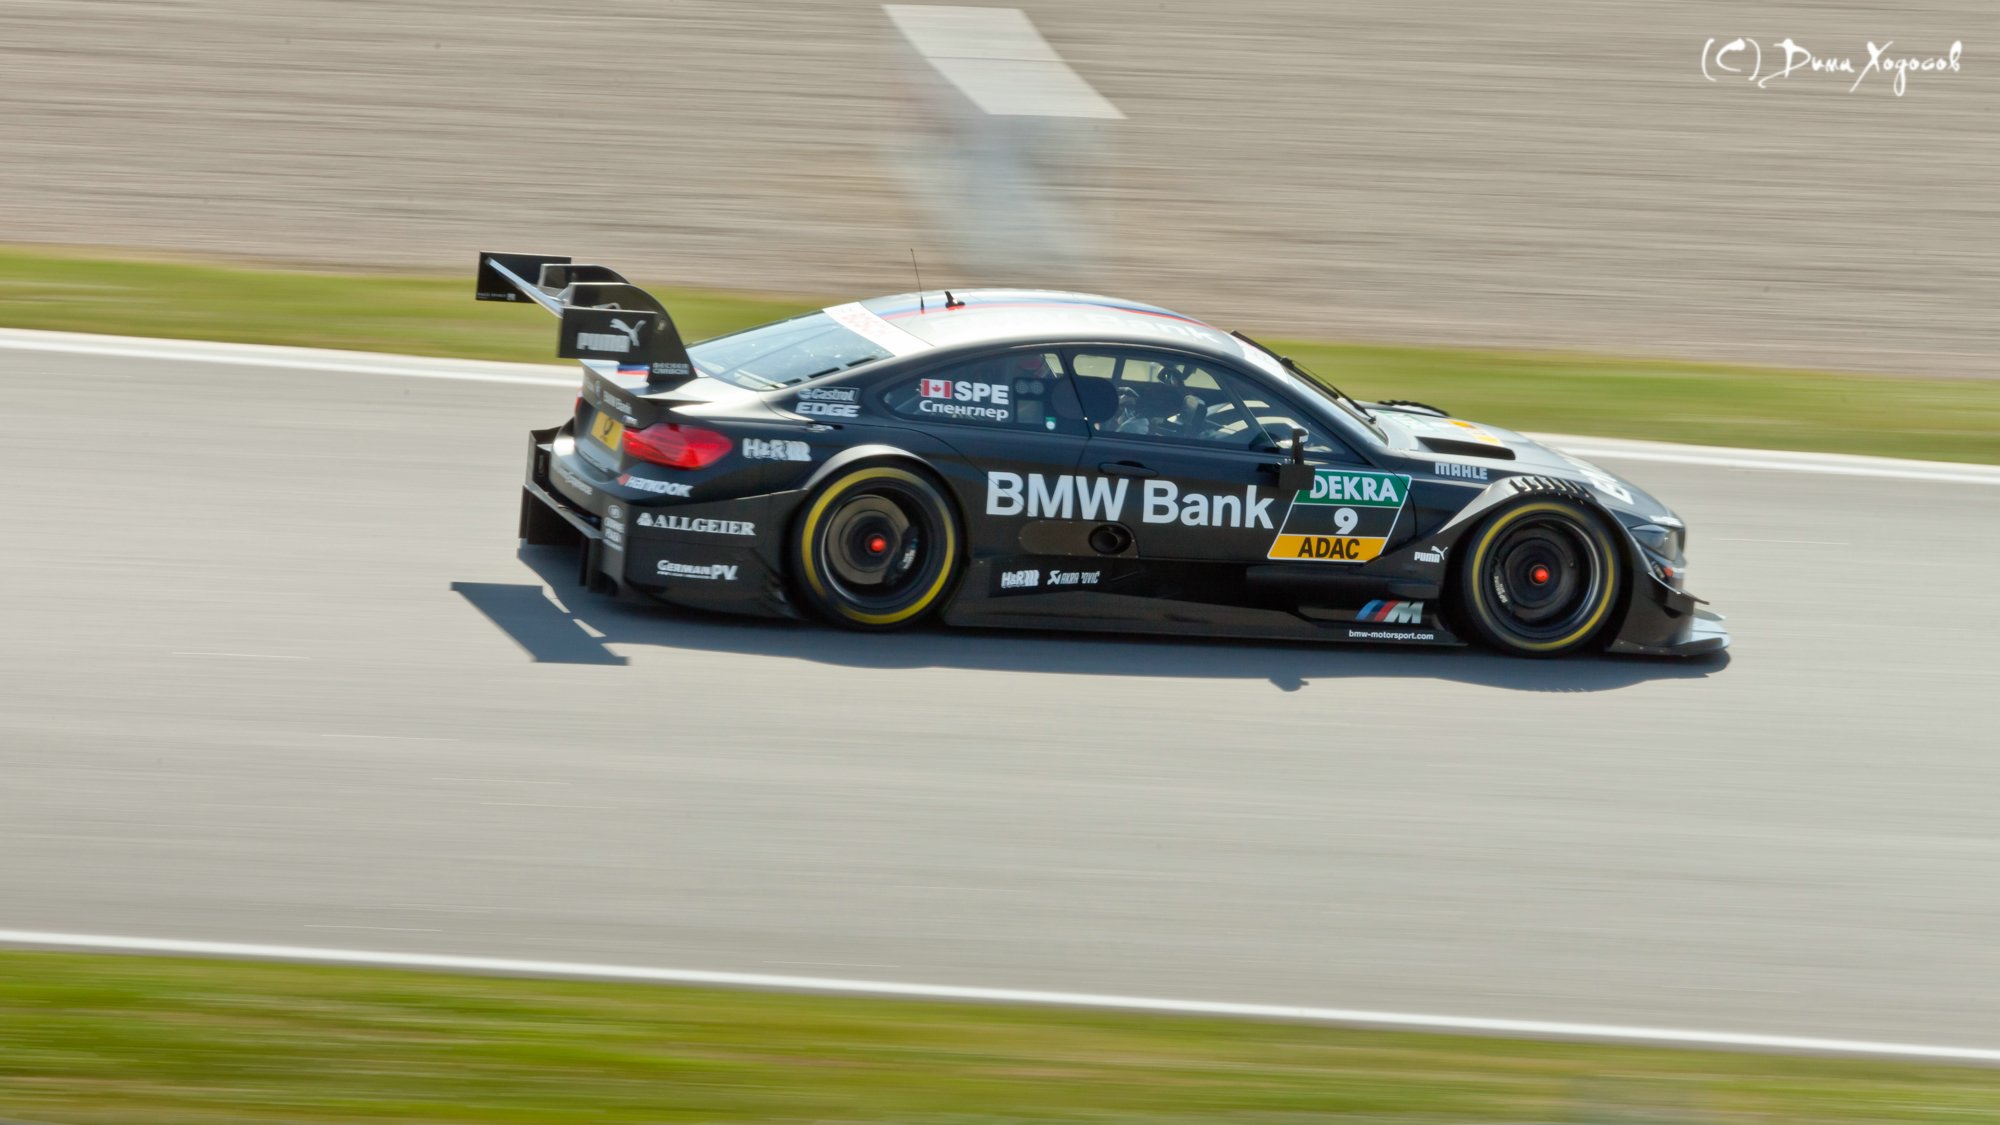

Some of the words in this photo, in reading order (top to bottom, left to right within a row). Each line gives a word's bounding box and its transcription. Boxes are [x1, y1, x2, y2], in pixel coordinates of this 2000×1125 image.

[810, 388, 855, 401] Castrol
[953, 380, 1009, 405] SPE
[795, 402, 861, 417] EDGE
[919, 399, 1009, 421] Спенглер
[1435, 461, 1488, 480] MAHLE
[1309, 475, 1399, 502] DEKRA
[986, 471, 1129, 521] BMW
[1142, 479, 1274, 529] Bank
[652, 513, 756, 536] ALLGEIER
[1333, 507, 1358, 535] 9
[1298, 537, 1360, 559] ADAC
[1414, 552, 1440, 563] PUMA
[1349, 629, 1434, 641] bmw-motorsport.com
